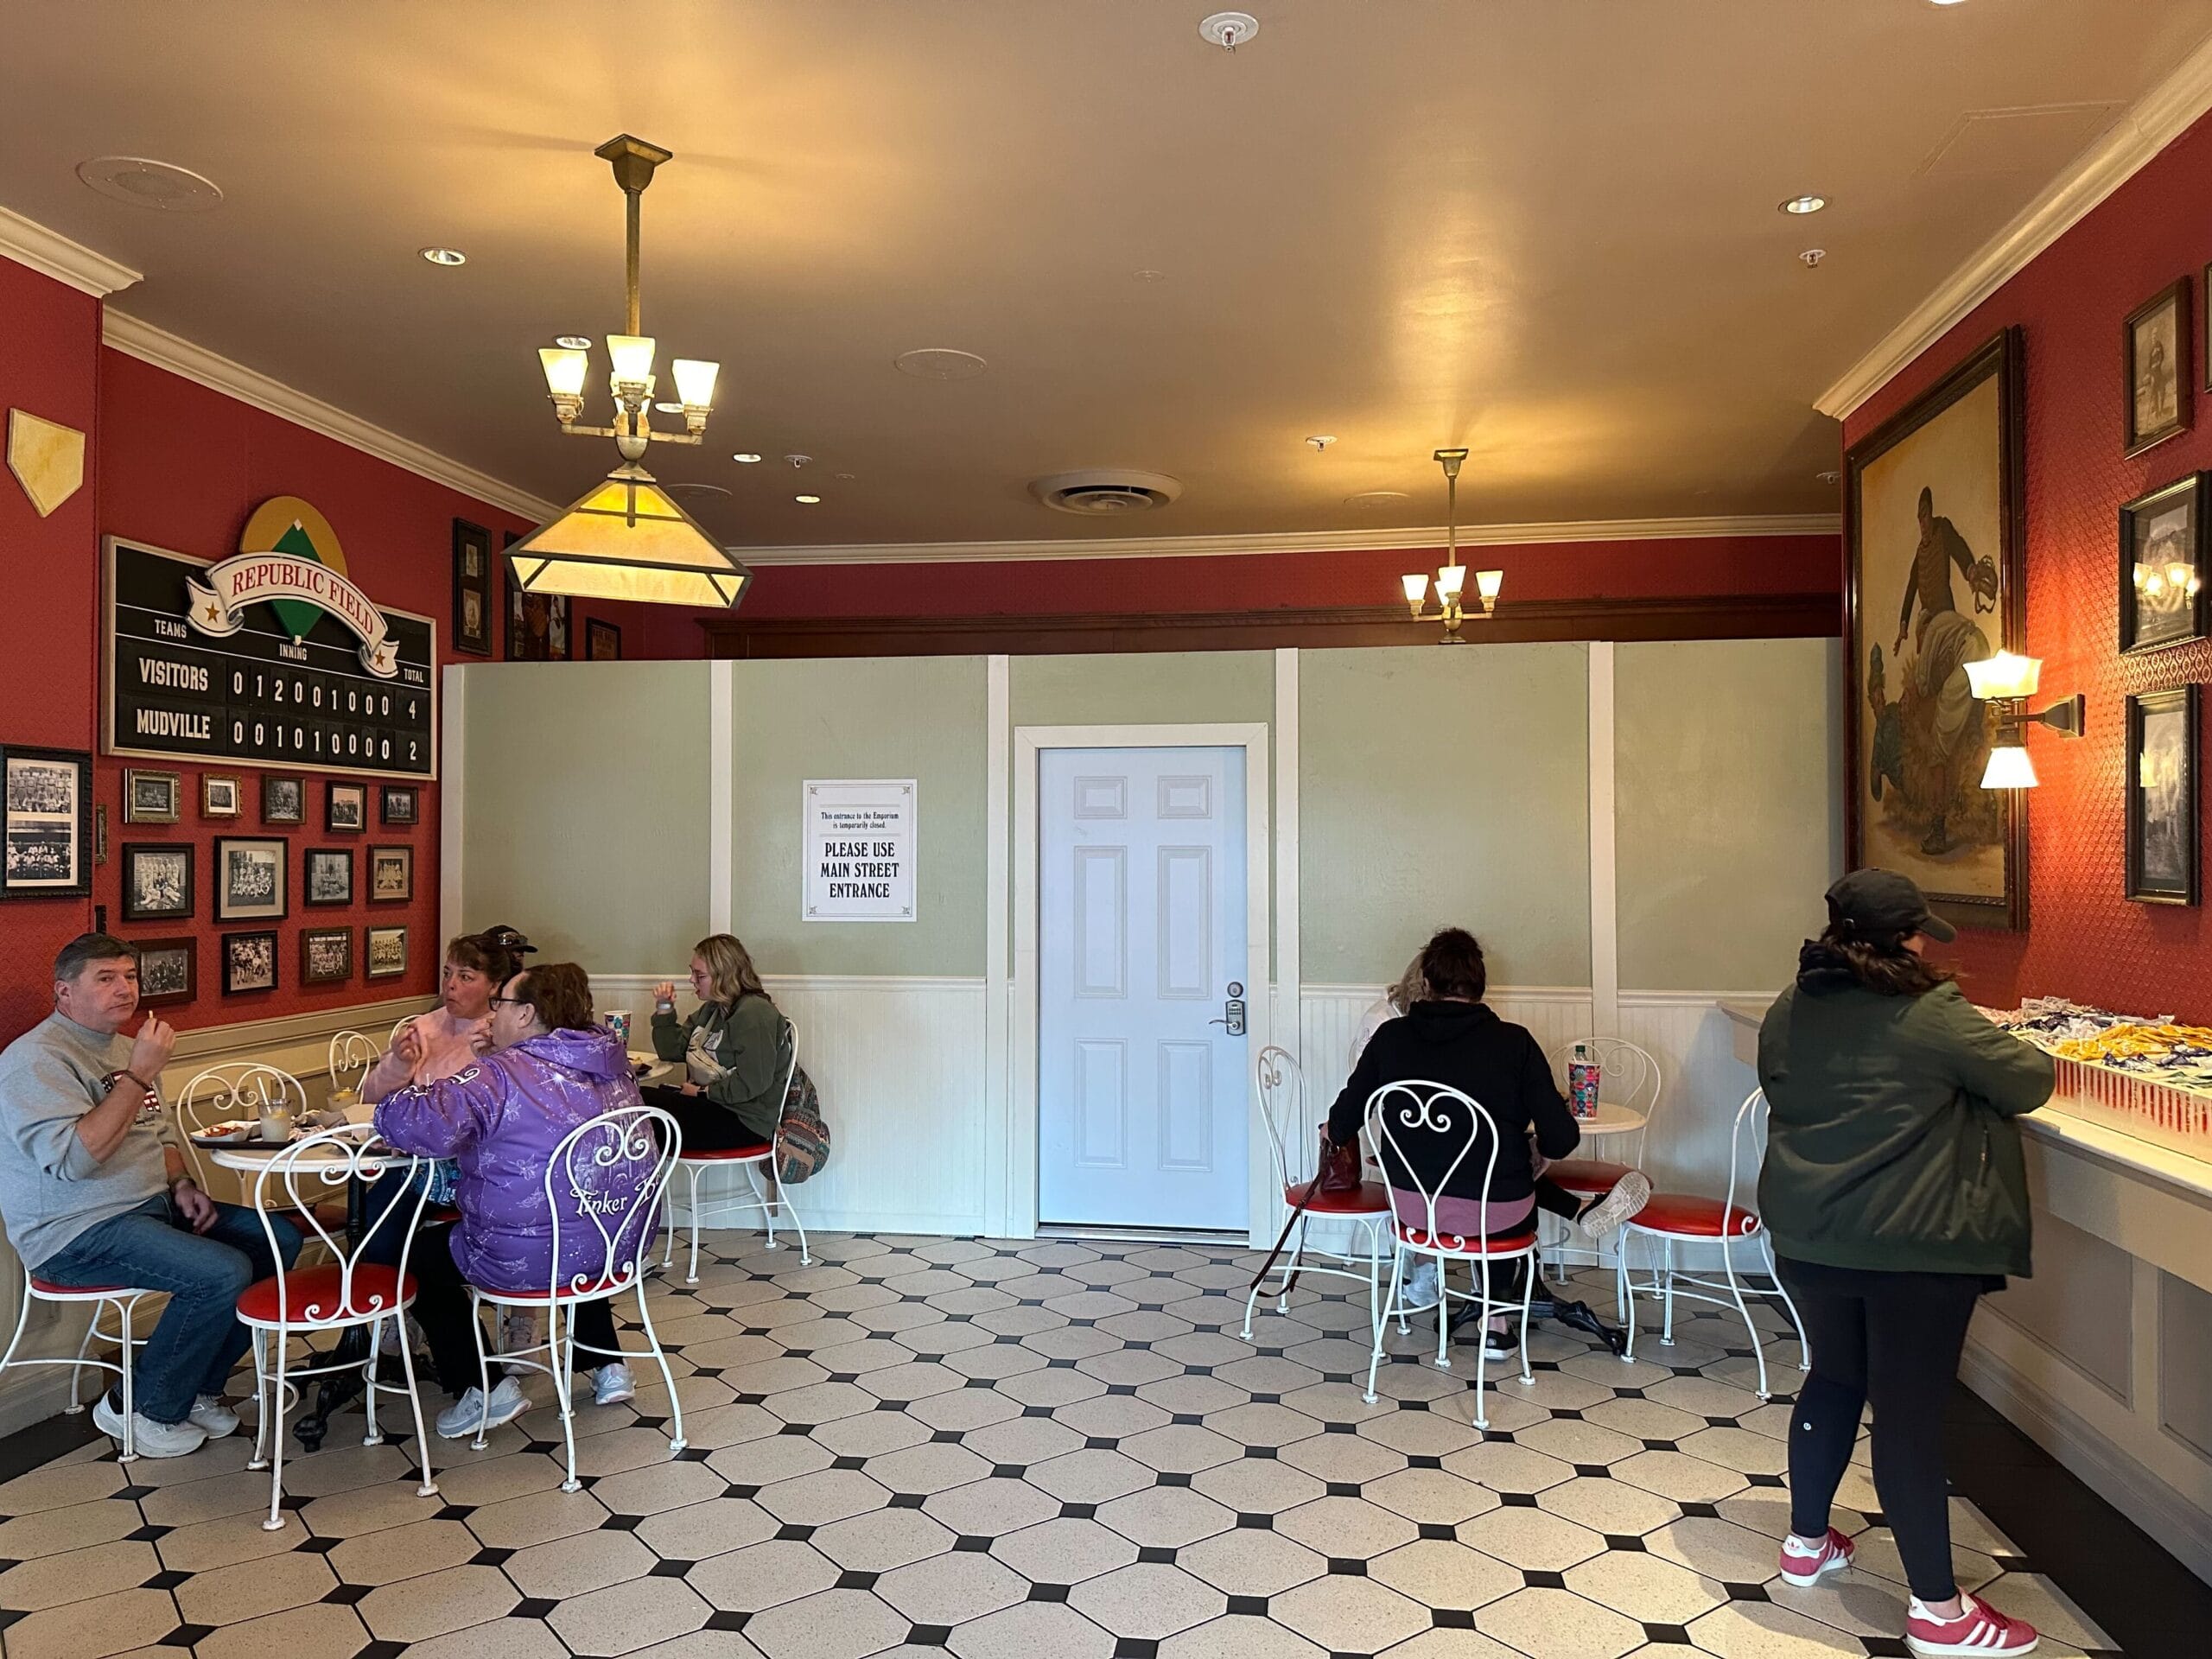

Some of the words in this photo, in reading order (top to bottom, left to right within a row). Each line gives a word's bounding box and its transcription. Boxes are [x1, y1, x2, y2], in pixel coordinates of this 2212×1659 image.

[232, 563, 324, 597] REPUBLIC
[328, 578, 373, 635] FIELD
[154, 619, 188, 639] TEAMS
[279, 643, 308, 661] INNING
[404, 668, 424, 683] TOTAL
[139, 658, 207, 691] VISITORS
[234, 672, 242, 694] 0
[257, 676, 263, 696] 1
[275, 679, 283, 702] 2
[295, 682, 302, 703] 0
[313, 686, 321, 707] 0
[332, 690, 337, 709] 1
[348, 691, 356, 712] 0
[365, 695, 373, 715] 0
[382, 696, 389, 715] 0
[409, 701, 416, 720] 4
[137, 709, 211, 740] MUDVILLE
[234, 721, 242, 743] 0
[255, 723, 263, 745] 0
[276, 726, 283, 747] 1
[295, 728, 302, 749] 0
[315, 731, 320, 752] 1
[332, 734, 340, 754] 0
[349, 734, 356, 754] 0
[365, 737, 373, 757] 0
[382, 739, 389, 760] 0
[410, 741, 416, 760] 2
[873, 811, 899, 821] Emporium
[840, 821, 868, 830] temporarily
[825, 842, 868, 857] PLEASE
[874, 842, 895, 857] USE
[821, 862, 850, 878] MAIN
[855, 862, 899, 878] STREET
[830, 882, 890, 898] ENTRANCE
